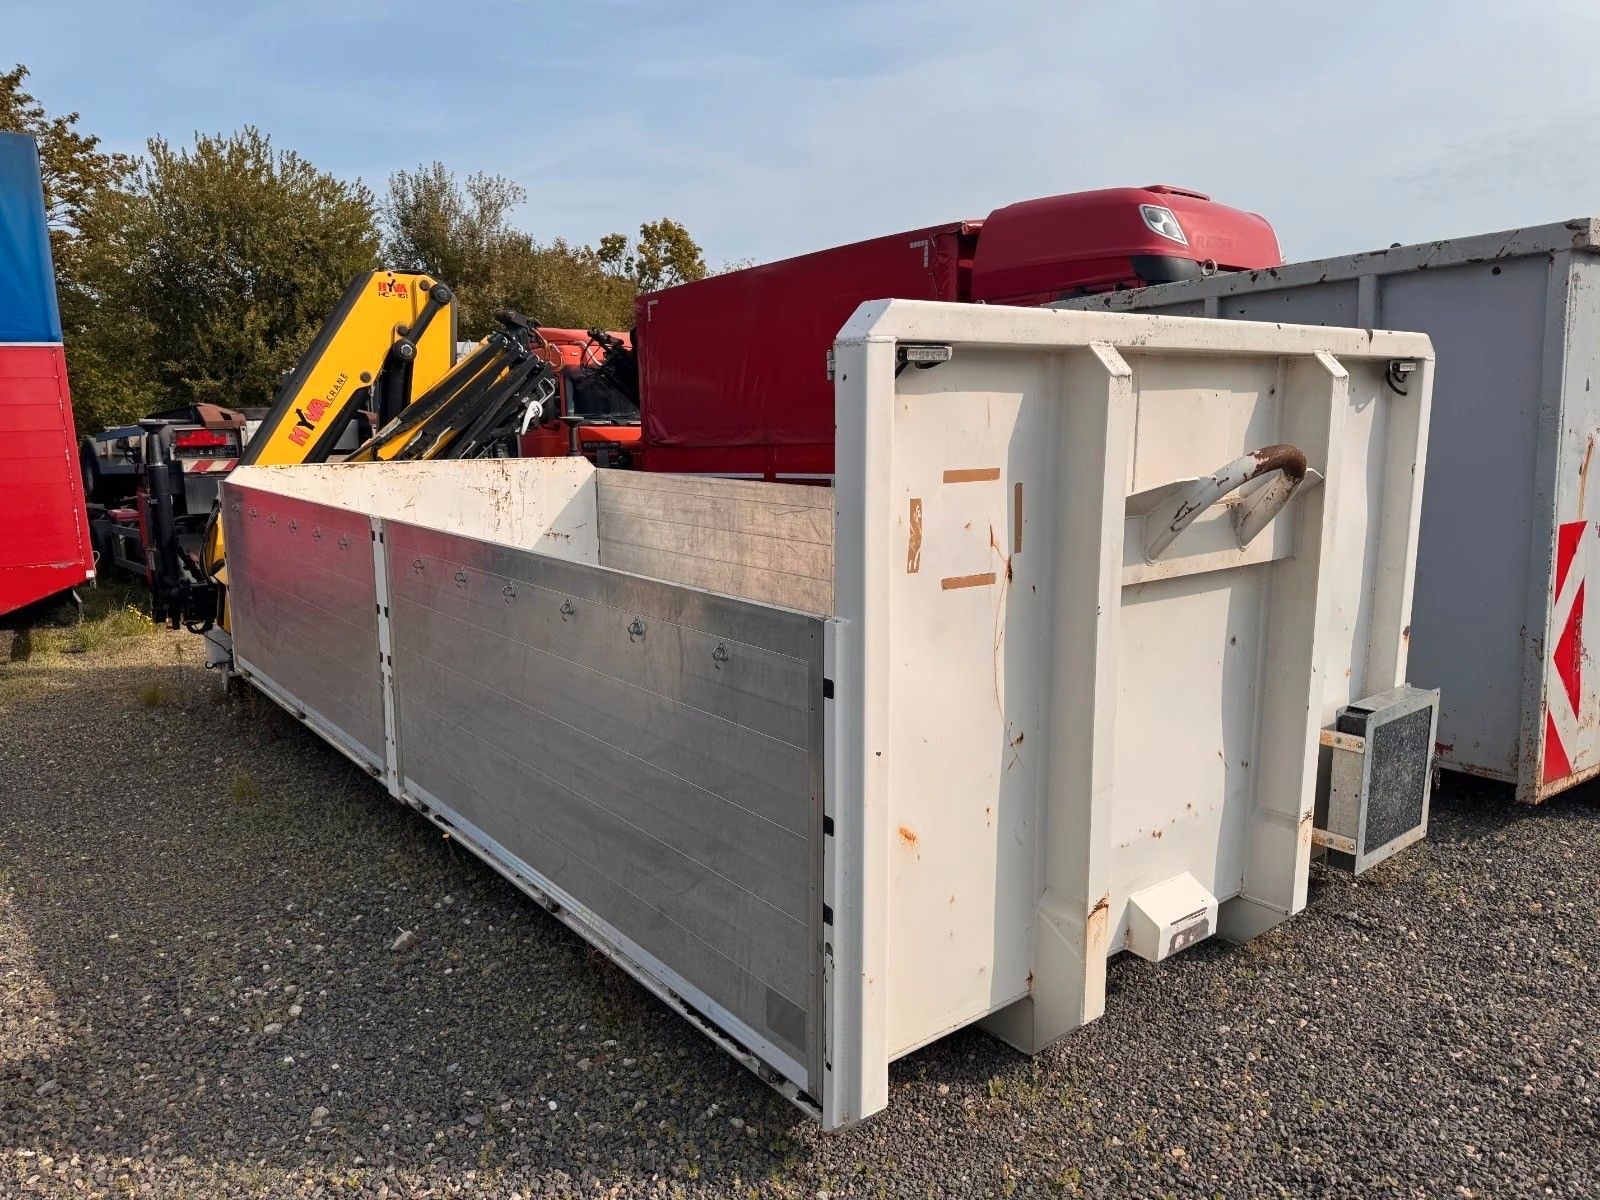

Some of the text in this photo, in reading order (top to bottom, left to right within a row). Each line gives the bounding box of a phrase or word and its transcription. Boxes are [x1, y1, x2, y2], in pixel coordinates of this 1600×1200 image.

[378, 279, 408, 294] HYVA
[287, 372, 349, 447] HYVA CRANE
